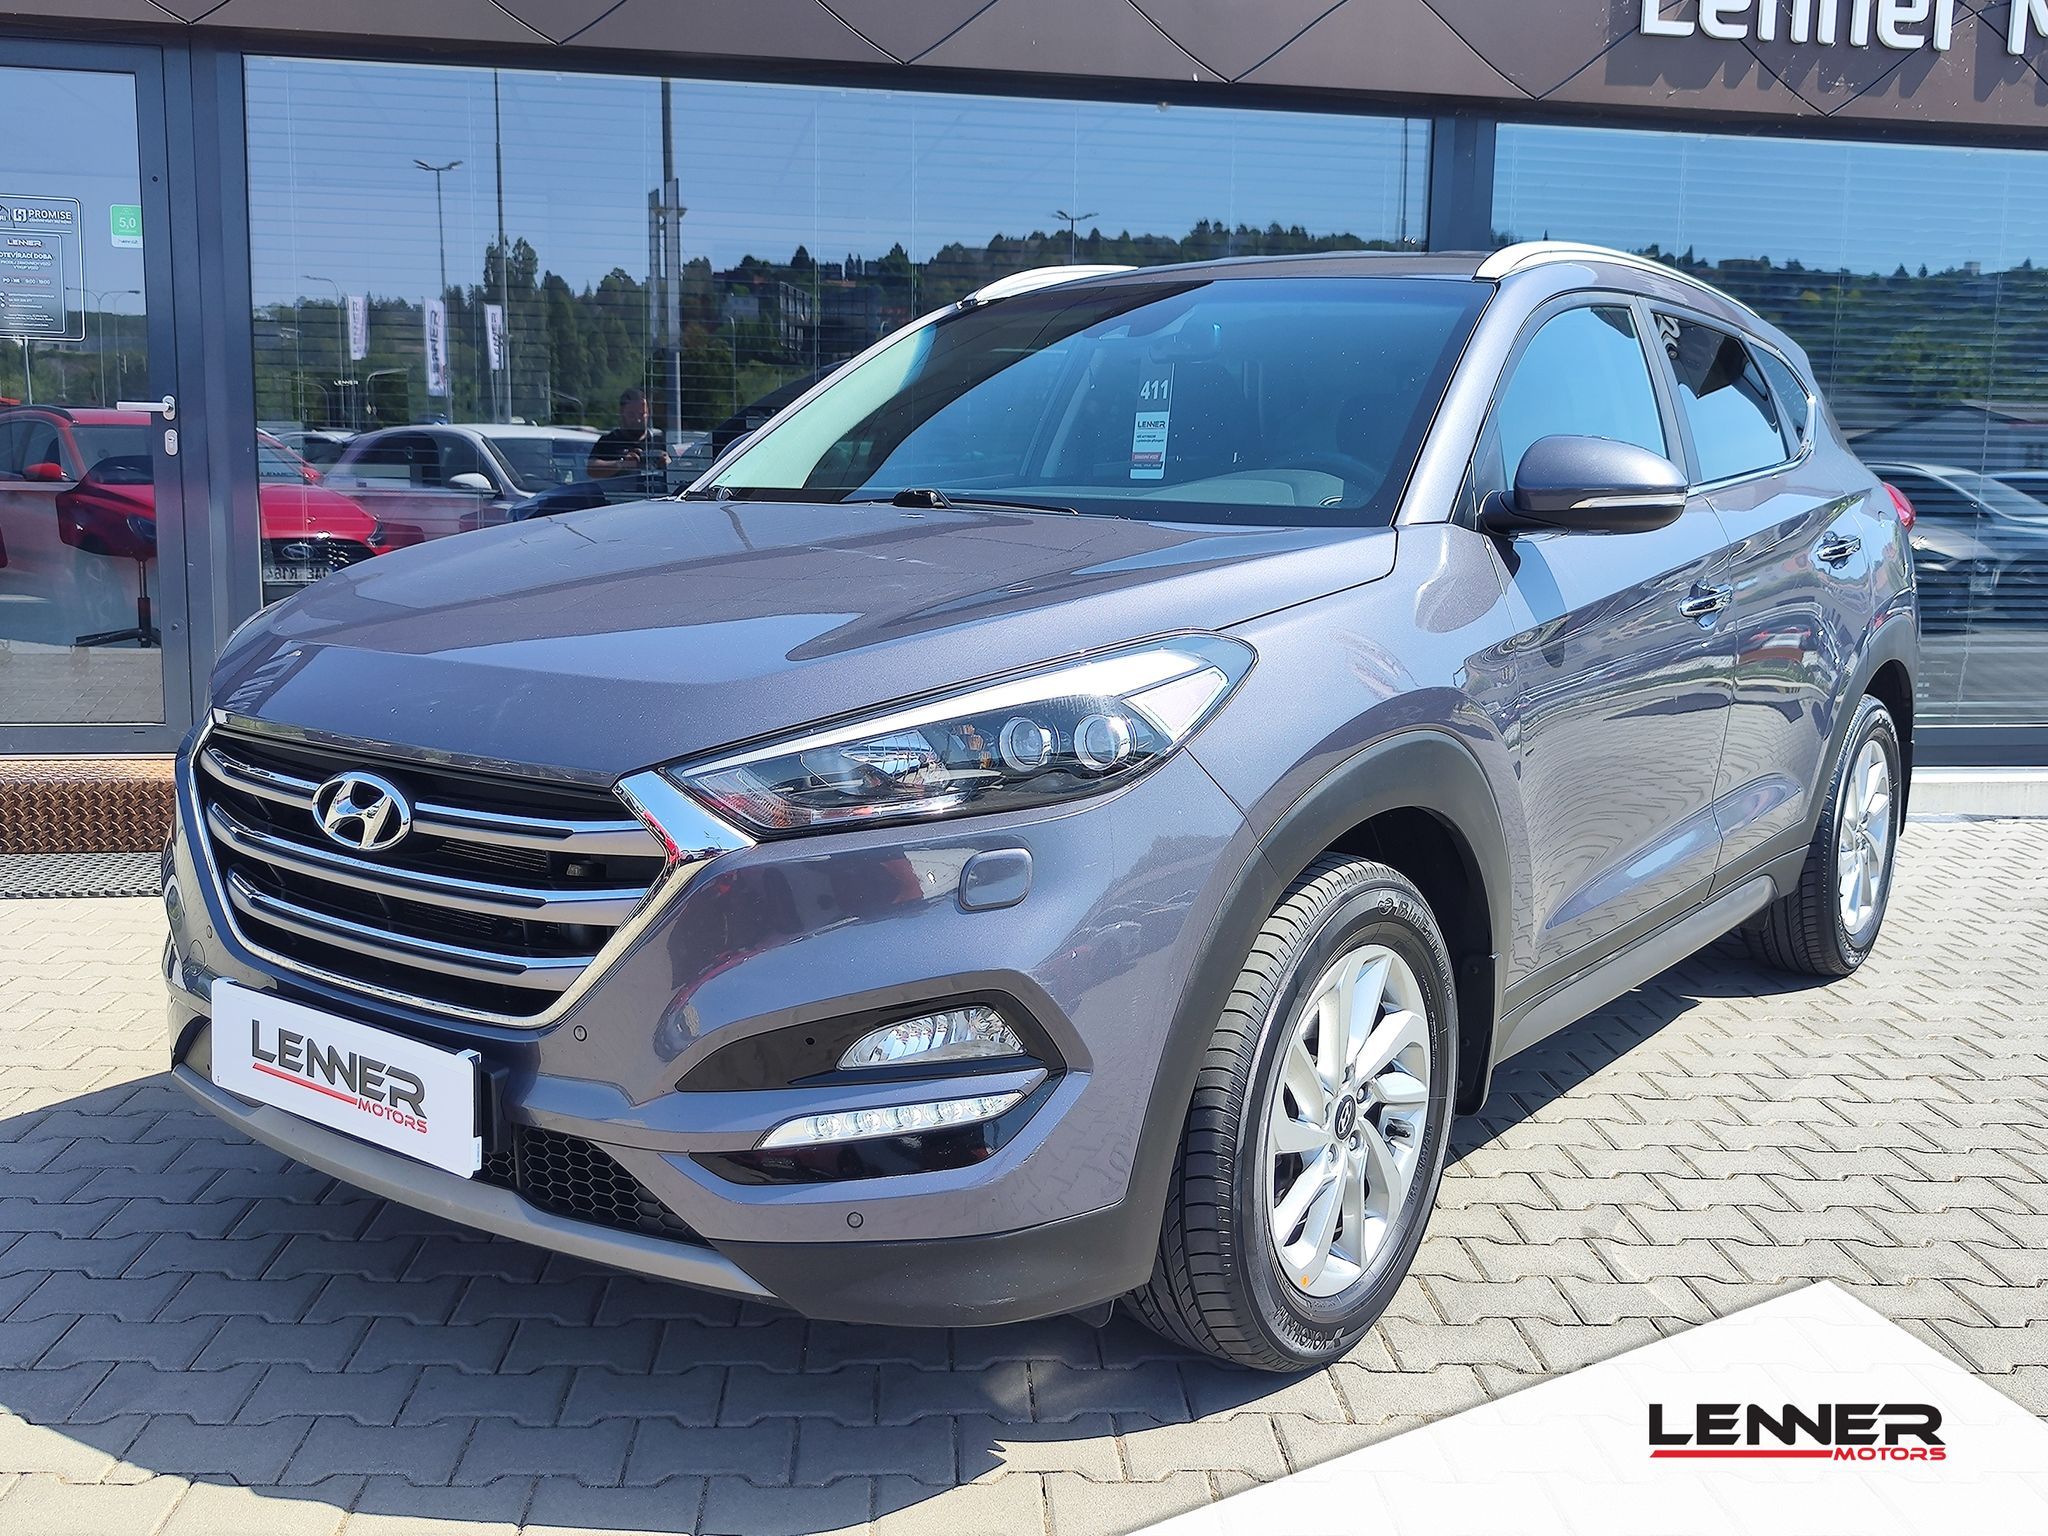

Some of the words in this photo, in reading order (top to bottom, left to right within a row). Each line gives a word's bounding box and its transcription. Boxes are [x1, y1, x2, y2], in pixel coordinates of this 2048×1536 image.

[28, 209, 72, 220] PROMISE
[119, 217, 136, 229] 5,0
[1140, 380, 1168, 400] 411
[1137, 420, 1166, 428] LENNER
[252, 1019, 428, 1119] LENNER
[357, 1098, 429, 1135] MOTORS
